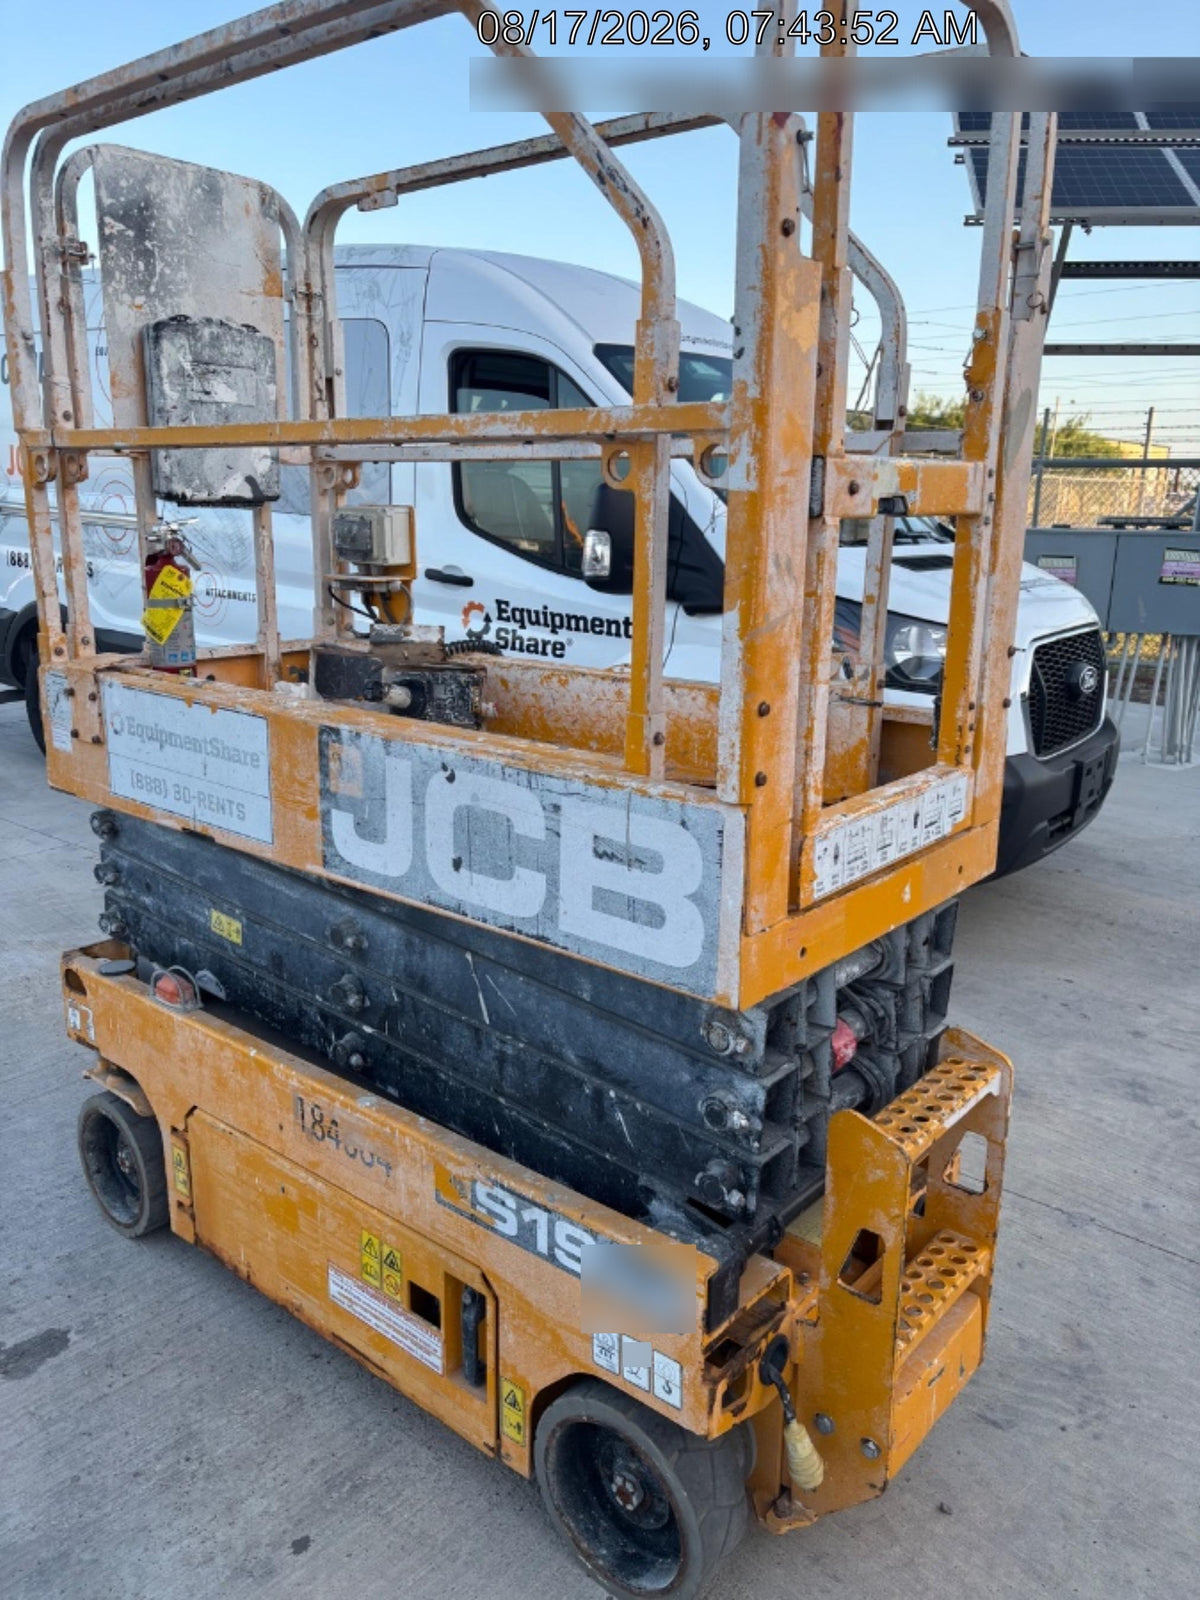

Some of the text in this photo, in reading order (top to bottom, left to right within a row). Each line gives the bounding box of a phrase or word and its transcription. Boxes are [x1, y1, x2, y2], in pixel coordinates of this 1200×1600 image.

[495, 599, 633, 638] Equipment
[495, 627, 566, 658] Share
[126, 715, 261, 769] EquipmentShare
[332, 755, 704, 968] JCB
